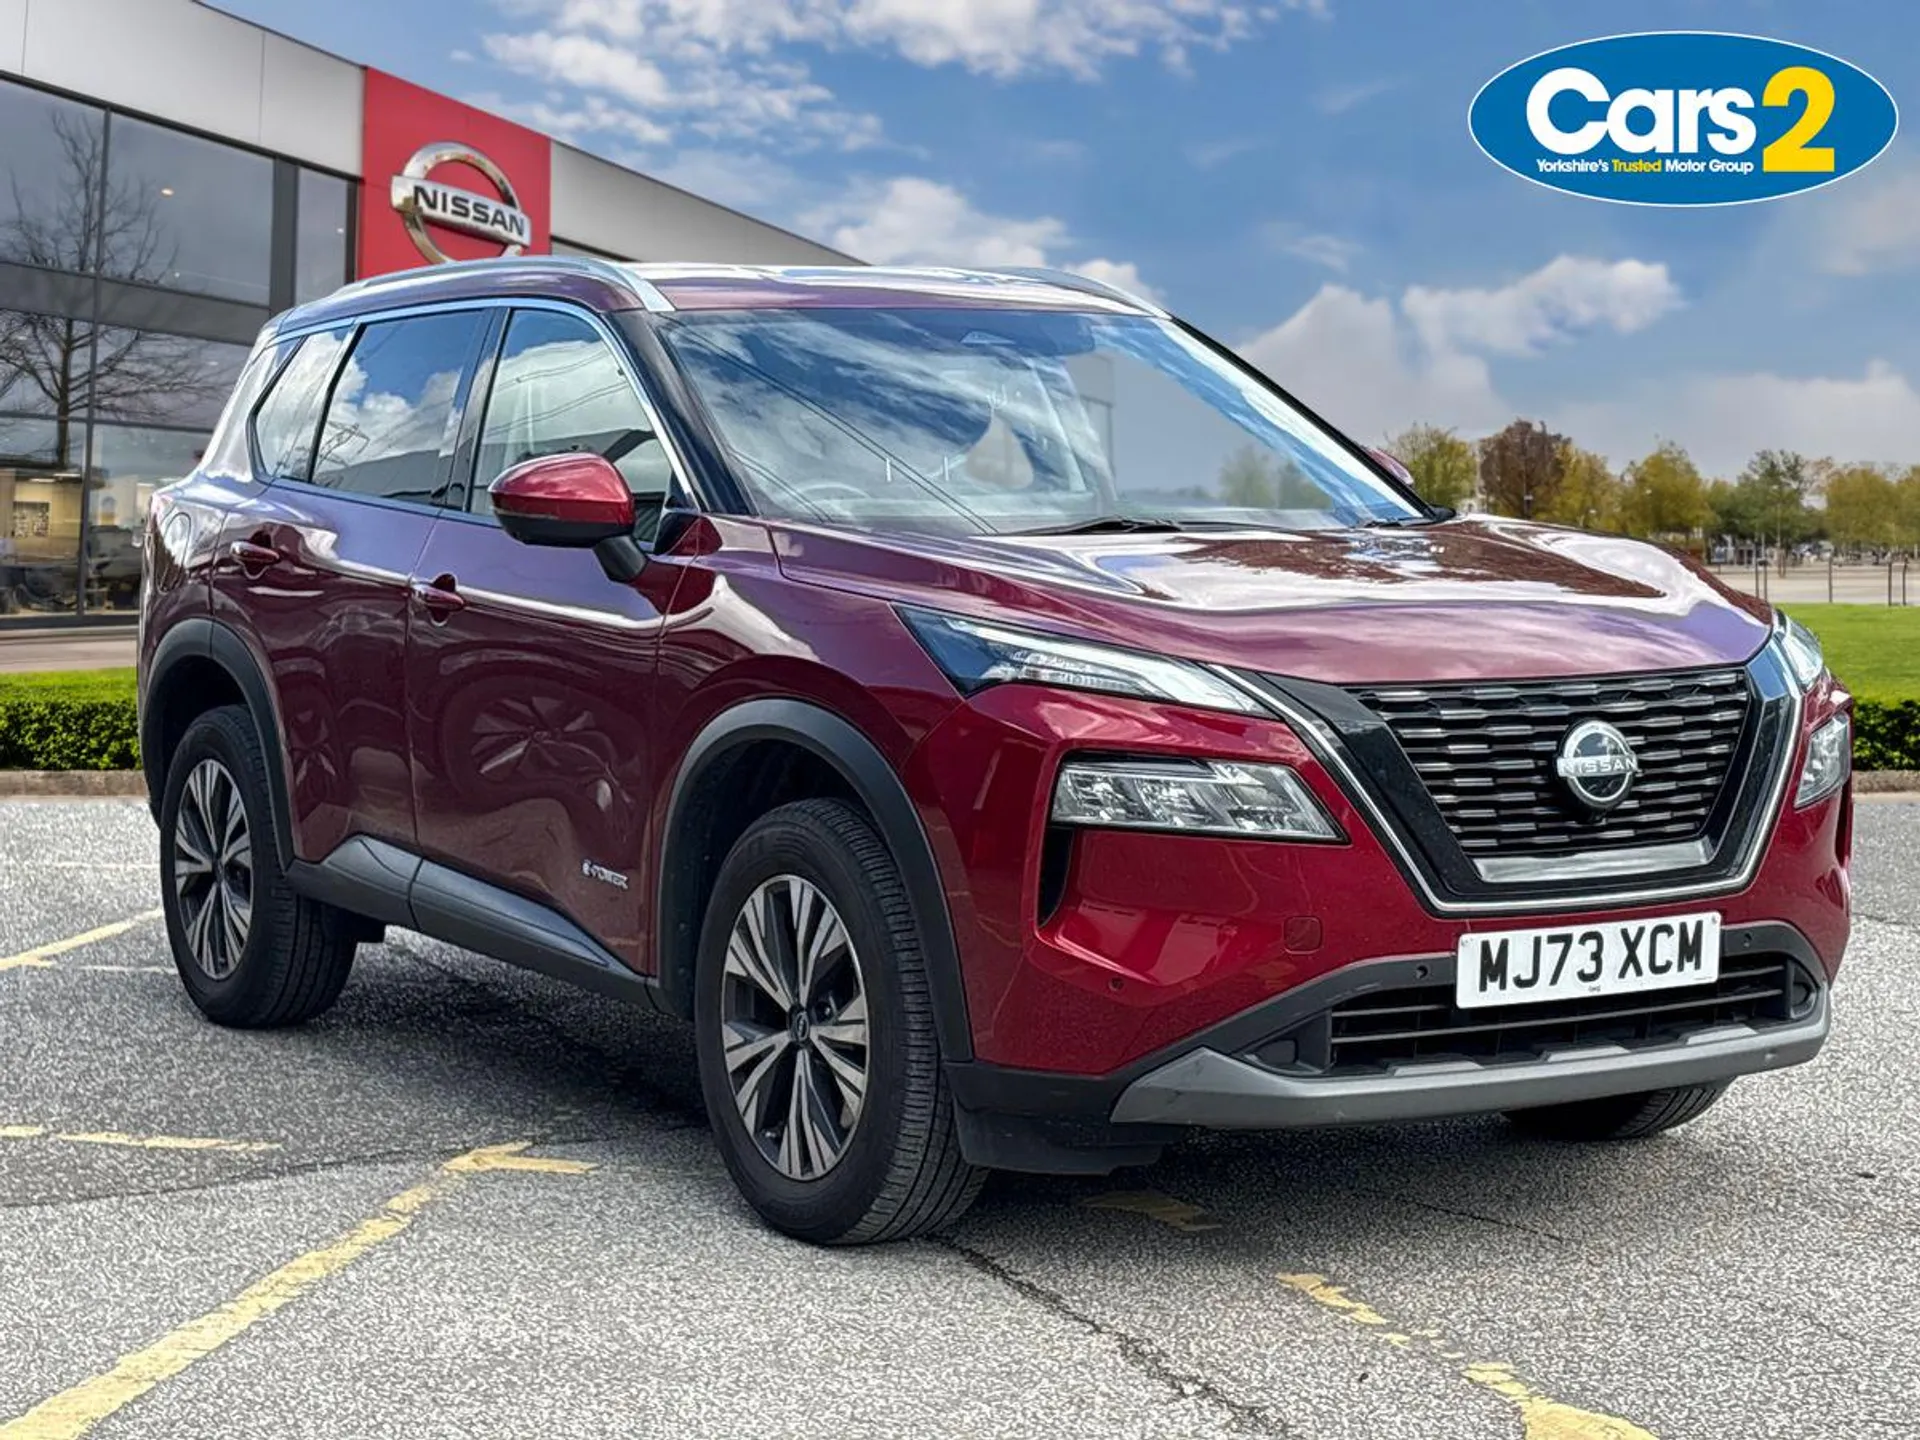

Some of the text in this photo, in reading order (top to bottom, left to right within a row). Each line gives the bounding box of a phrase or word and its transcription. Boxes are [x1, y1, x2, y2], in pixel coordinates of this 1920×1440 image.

[413, 184, 525, 237] NISSAN
[1562, 758, 1637, 774] NISSAN
[1478, 919, 1704, 993] MJ73 XCM
